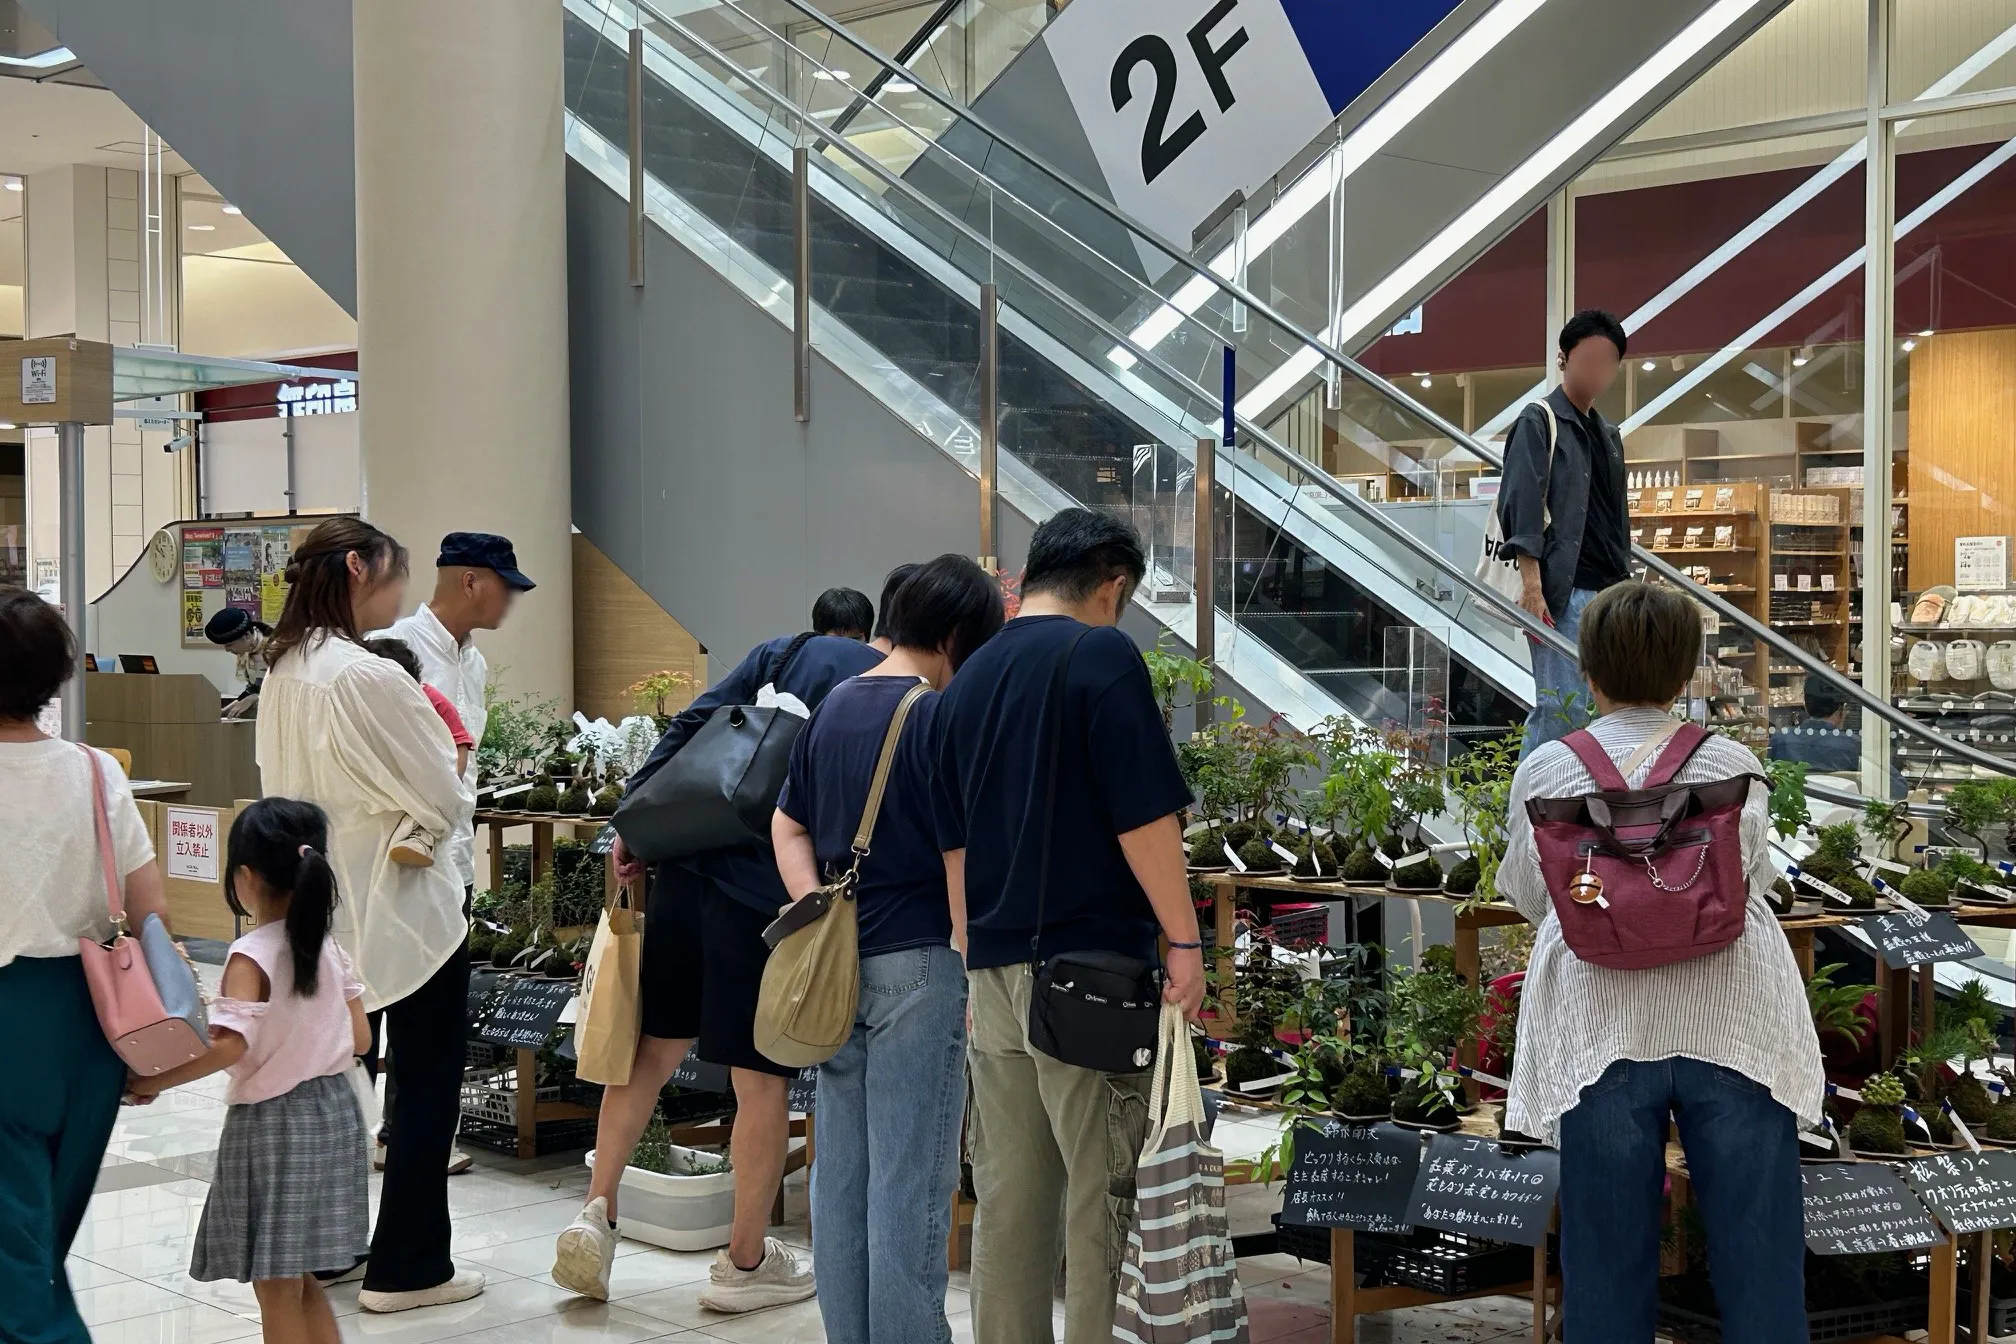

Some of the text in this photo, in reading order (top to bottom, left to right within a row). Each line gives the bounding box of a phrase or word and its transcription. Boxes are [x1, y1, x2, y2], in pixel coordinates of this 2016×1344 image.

[1110, 0, 1250, 186] 2F
[172, 821, 213, 839] 関係者以外
[176, 841, 210, 858] 立入禁止
